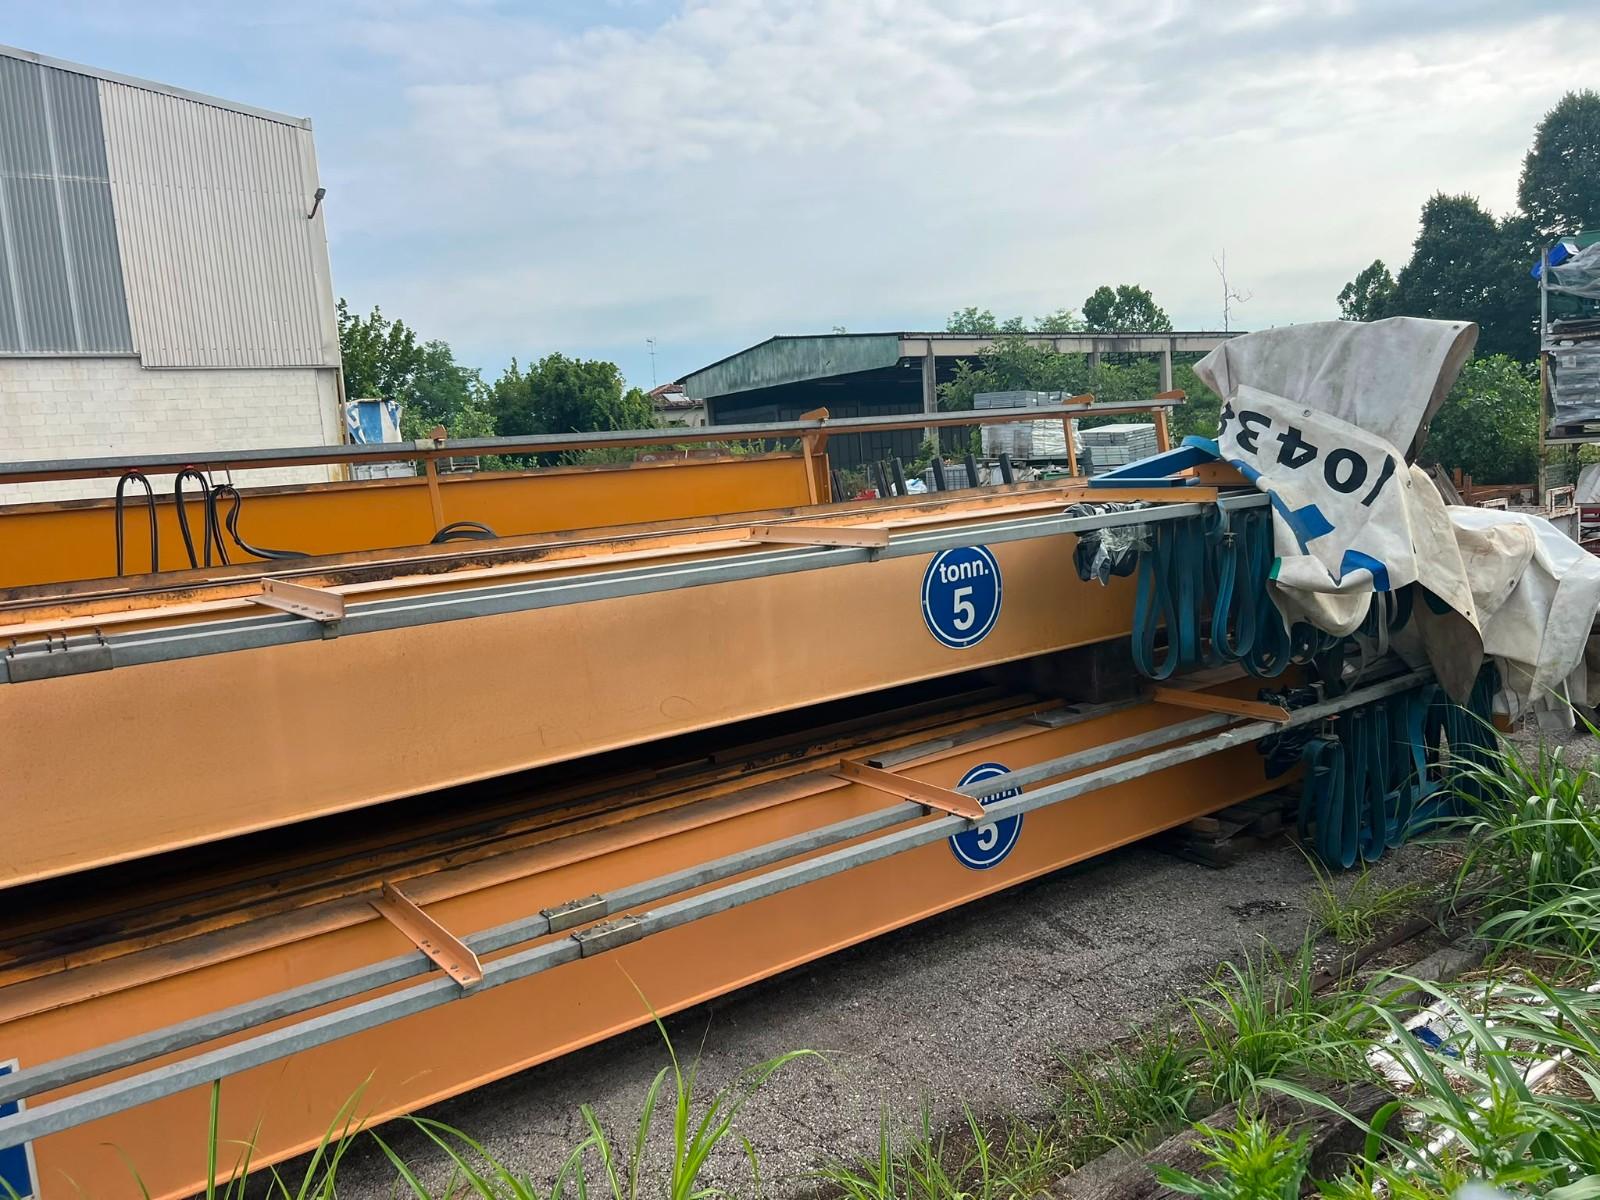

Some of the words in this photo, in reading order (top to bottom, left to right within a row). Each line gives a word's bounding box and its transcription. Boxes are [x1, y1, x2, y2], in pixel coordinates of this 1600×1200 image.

[939, 559, 989, 584] tonn.
[953, 586, 975, 631] 5
[977, 822, 999, 851] 5
